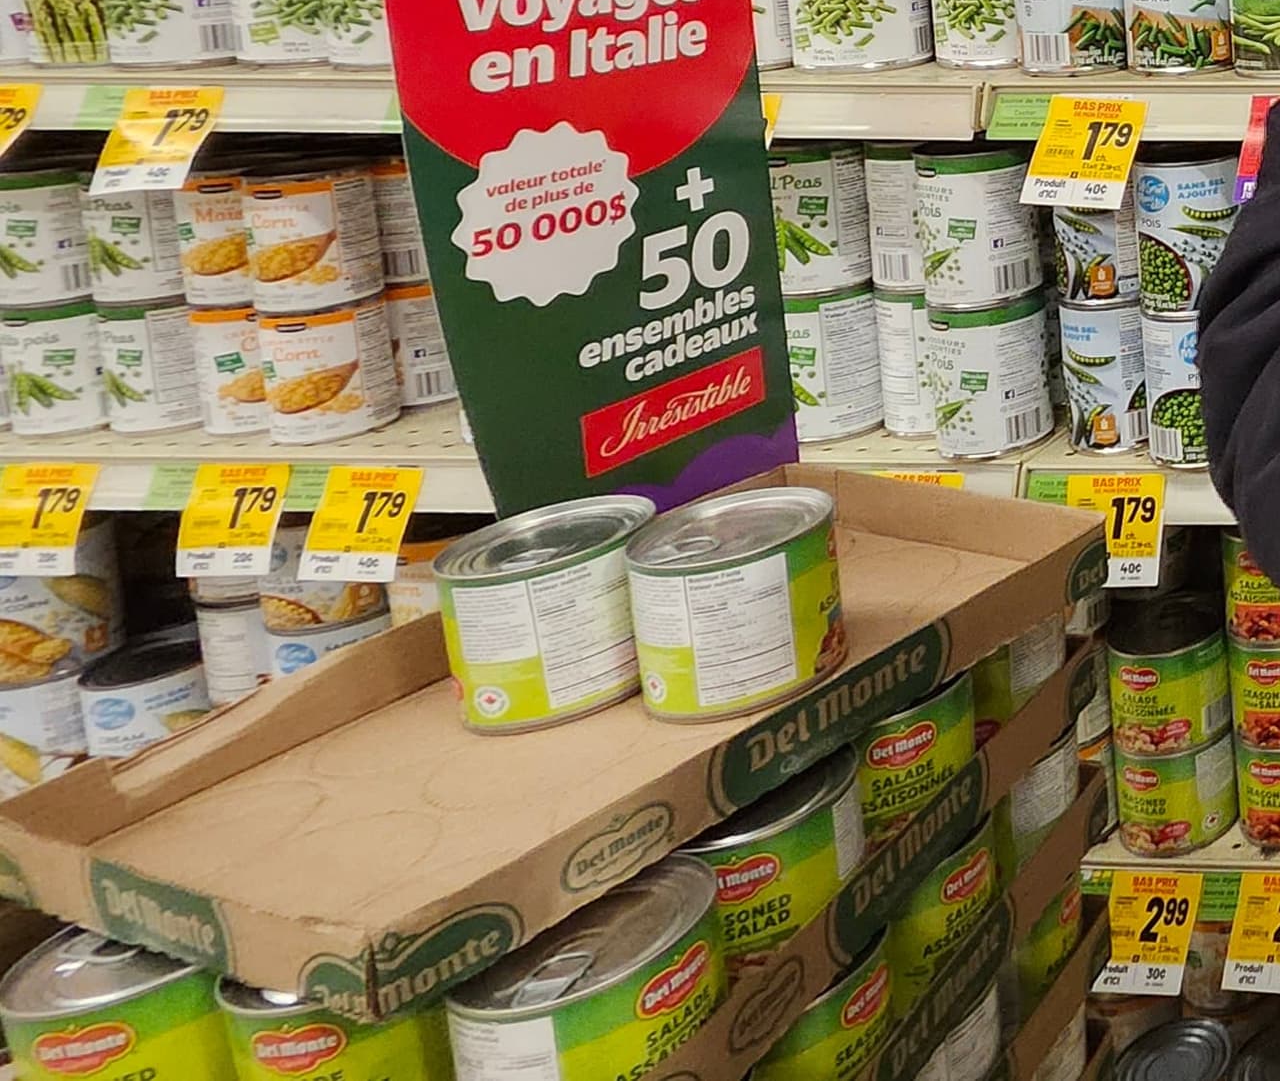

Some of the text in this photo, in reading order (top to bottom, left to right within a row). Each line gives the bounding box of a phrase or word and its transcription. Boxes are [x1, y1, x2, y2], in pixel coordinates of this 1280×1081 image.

[469, 12, 707, 93] en Italie
[486, 176, 547, 197] valeur
[504, 181, 595, 213] de plus de
[1034, 178, 1066, 189] Produit
[1084, 183, 1107, 195] 40¢
[471, 223, 522, 258] 50
[639, 210, 750, 310] 50
[578, 285, 755, 368] ensembles
[624, 310, 758, 382] cadeaux
[600, 367, 751, 458] Irrésistible
[746, 644, 928, 773] Del Monte
[872, 761, 935, 792] SALADE
[1234, 964, 1263, 973] Produit
